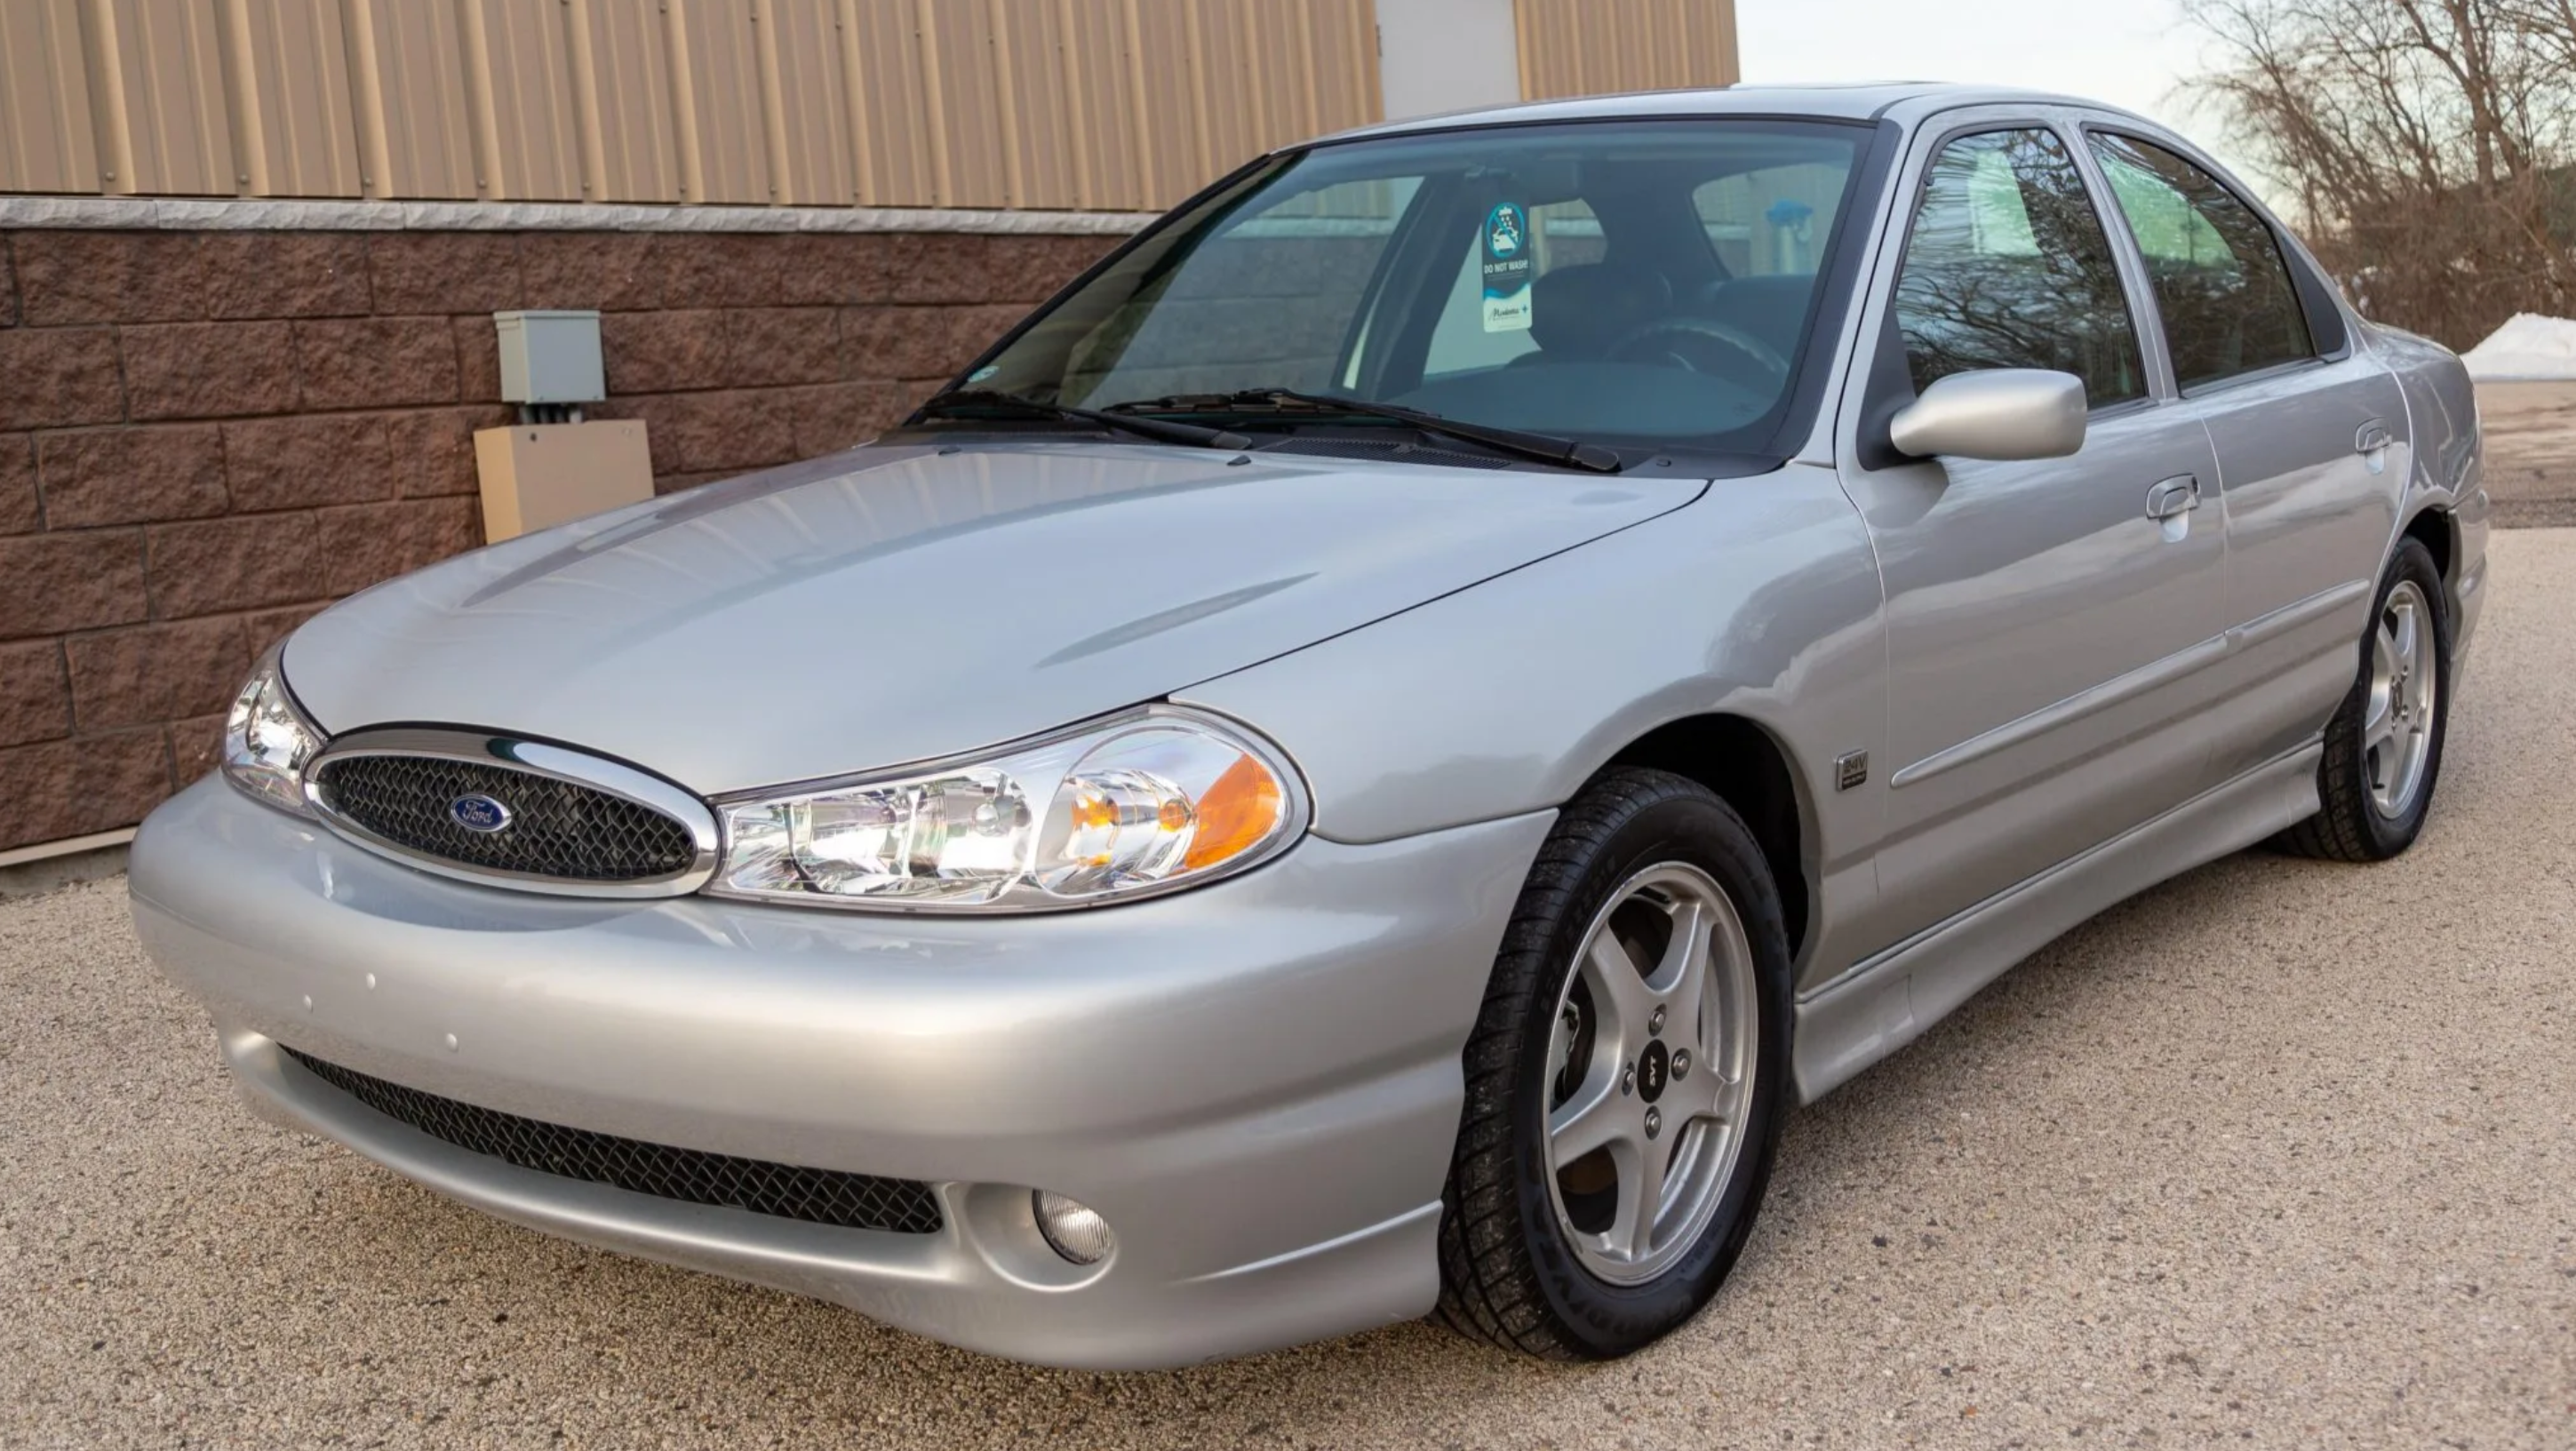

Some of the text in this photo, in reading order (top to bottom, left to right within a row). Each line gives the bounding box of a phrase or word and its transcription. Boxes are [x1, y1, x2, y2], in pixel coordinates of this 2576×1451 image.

[1484, 264, 1494, 274] DO
[1495, 262, 1507, 272] NOT
[463, 801, 493, 824] Ford
